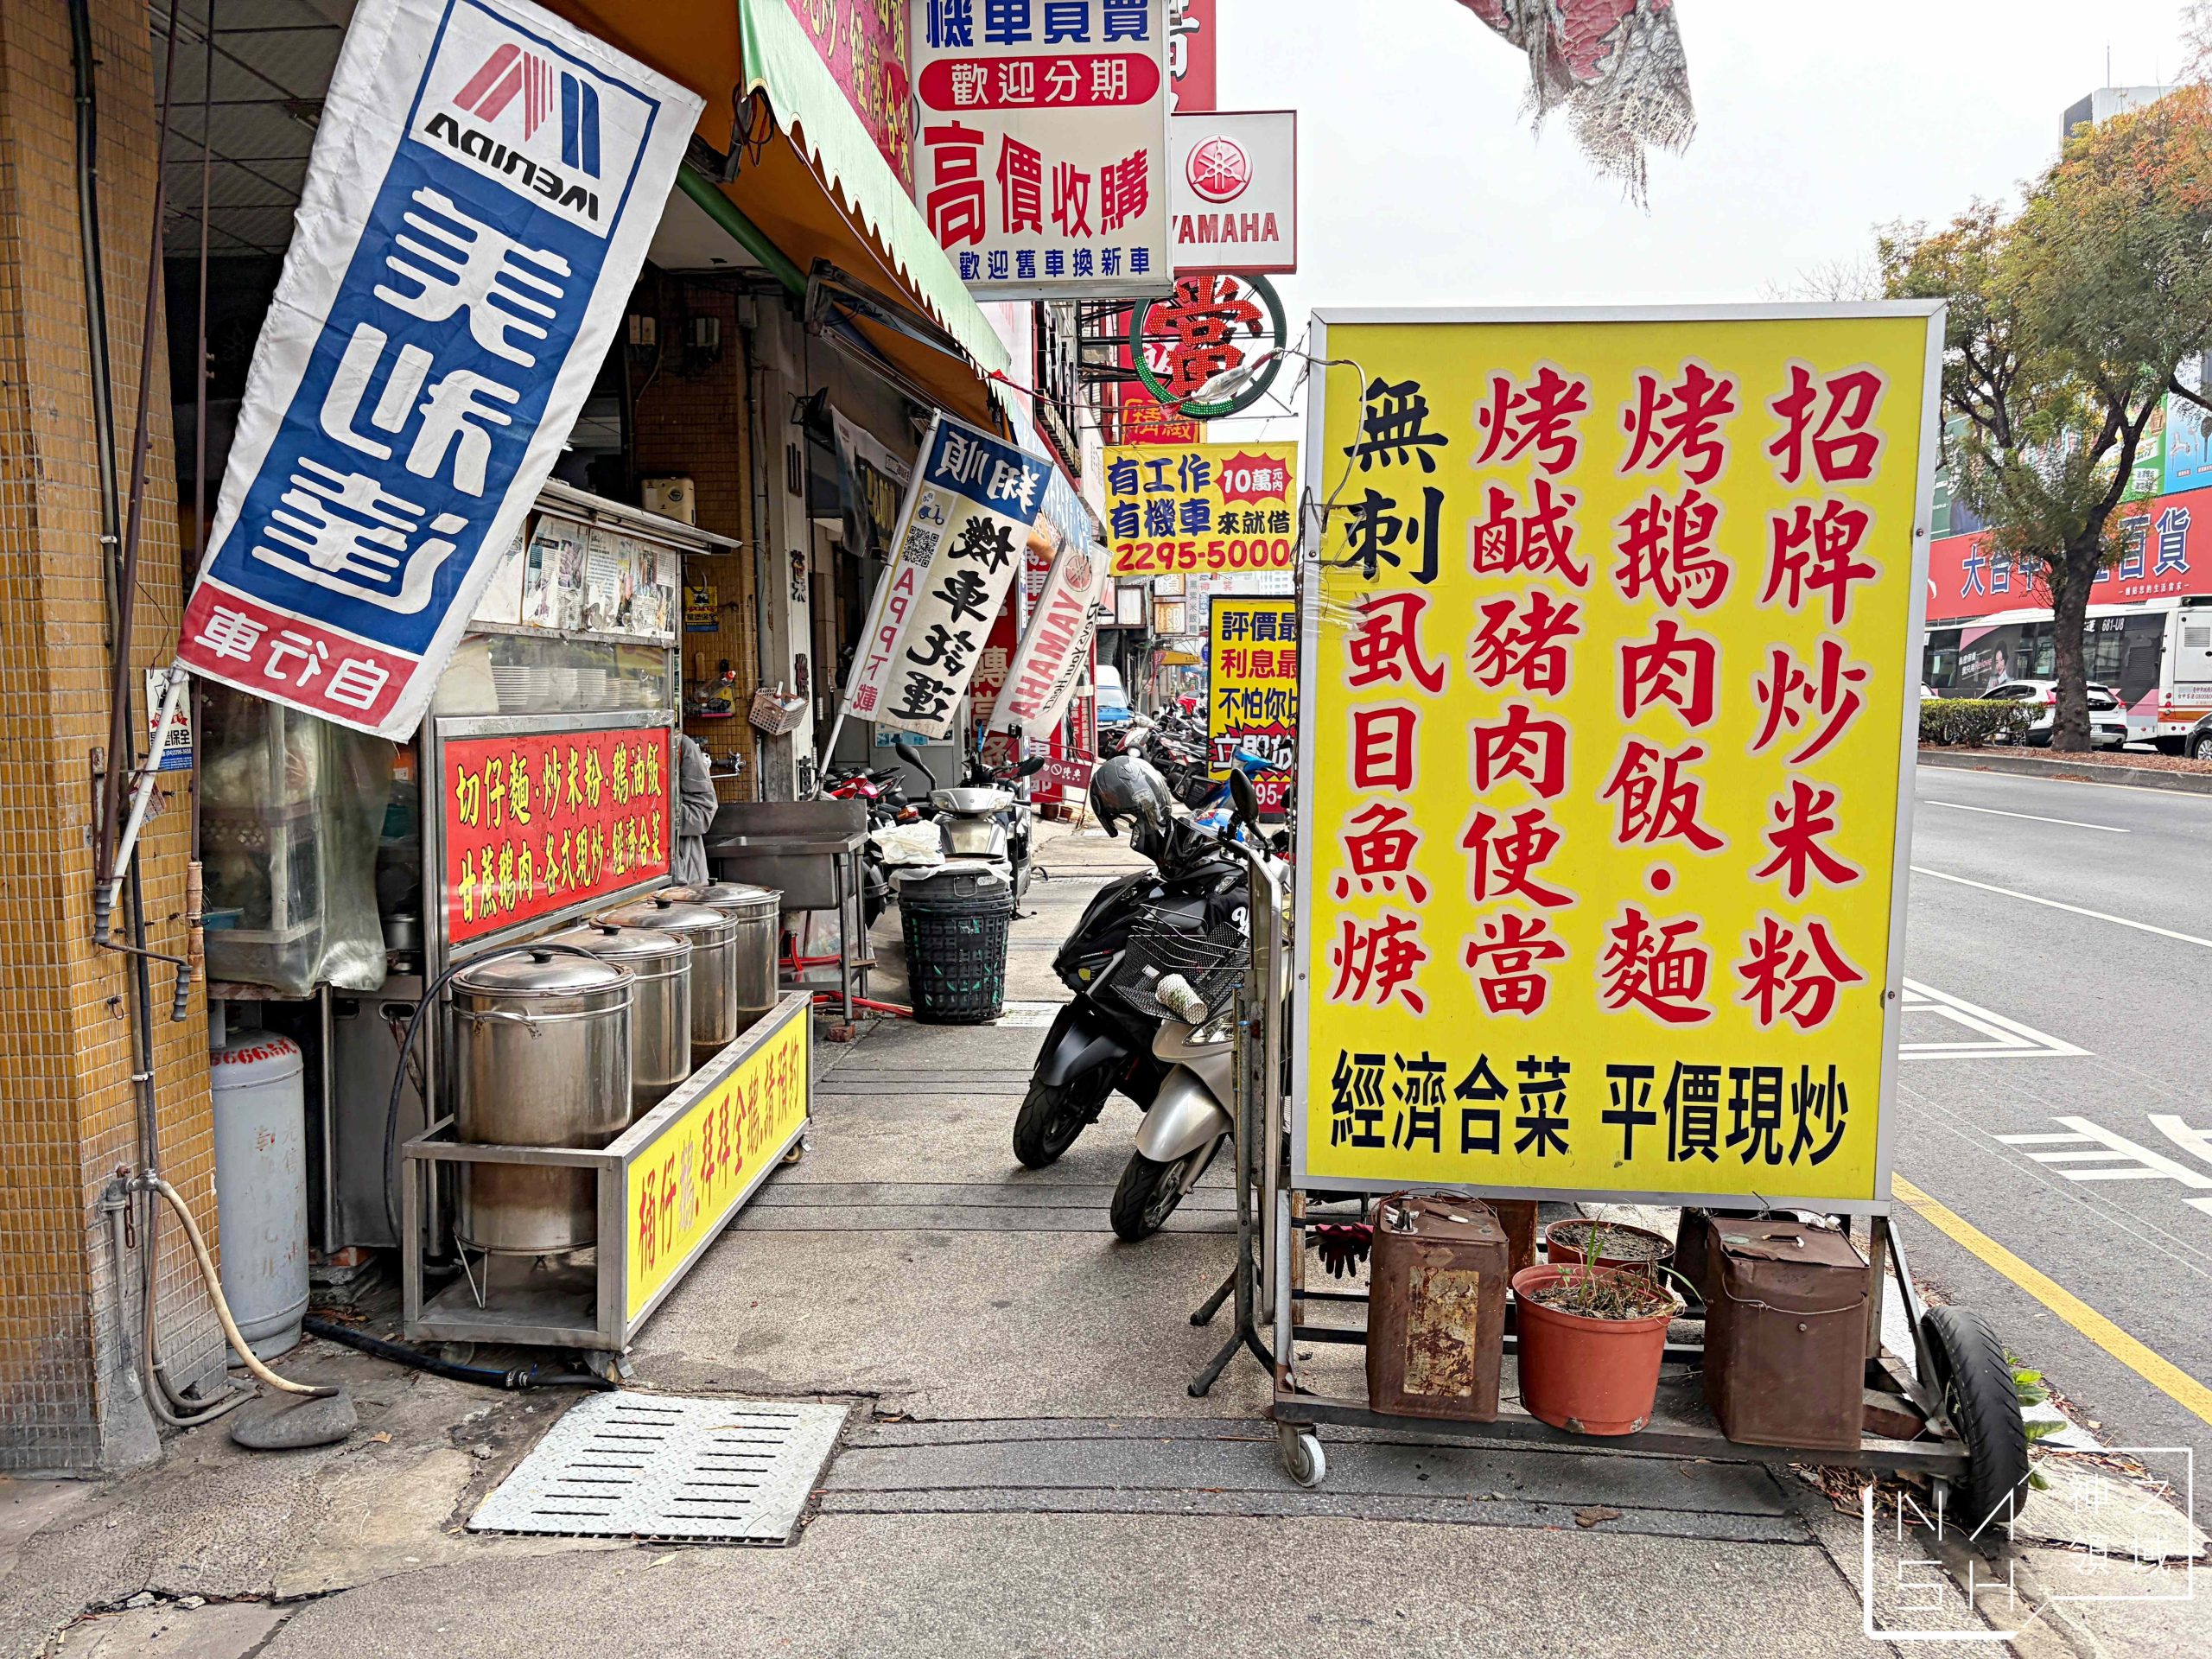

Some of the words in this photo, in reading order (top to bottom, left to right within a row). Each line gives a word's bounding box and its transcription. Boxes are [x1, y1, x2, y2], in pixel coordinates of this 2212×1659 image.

[950, 58, 1128, 105] 歡迎分期
[923, 119, 1150, 251] 高價收購
[1173, 213, 1280, 245] YAMAHA
[959, 246, 1151, 281] 歡迎舊車換新車
[1107, 454, 1212, 497] 有工作
[1223, 468, 1270, 493] 10萬
[1109, 498, 1212, 540] 有機車
[1217, 511, 1291, 536] 來就借
[1116, 539, 1292, 572] 2295-5000
[2101, 618, 2125, 632] 681-U8
[1461, 364, 1589, 1017] 烤鹹豬肉便當
[1738, 364, 1884, 1030] 招牌炒米粉
[1330, 1047, 1571, 1160] 經濟合菜
[1603, 1058, 1847, 1168] 平價現炒
